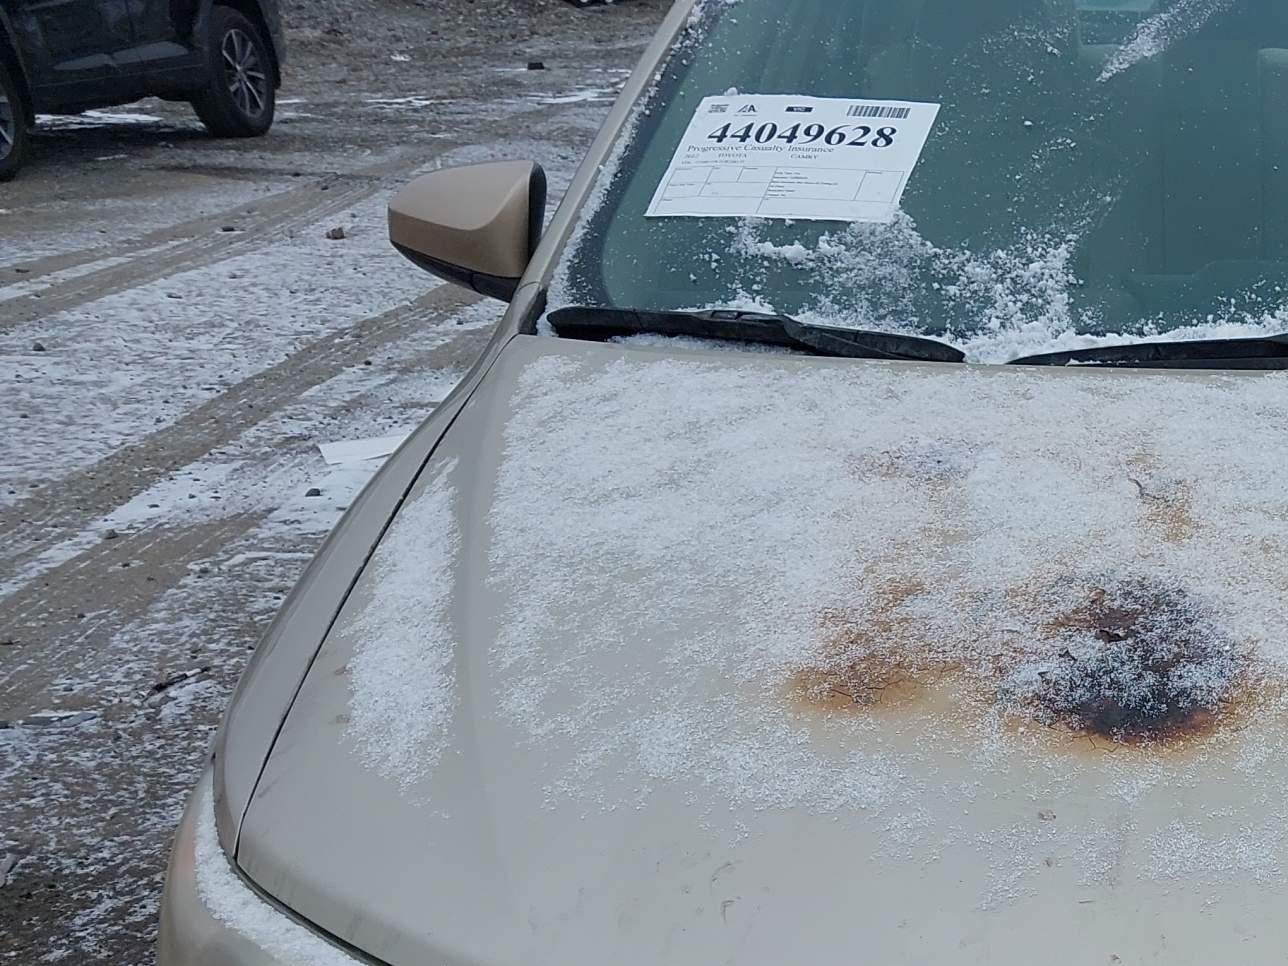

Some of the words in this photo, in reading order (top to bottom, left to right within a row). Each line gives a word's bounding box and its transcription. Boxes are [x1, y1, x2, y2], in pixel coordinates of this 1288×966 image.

[707, 122, 897, 148] 44049628
[687, 144, 741, 153] Progressive
[743, 144, 783, 153] Casualty
[788, 145, 834, 153] Insurance
